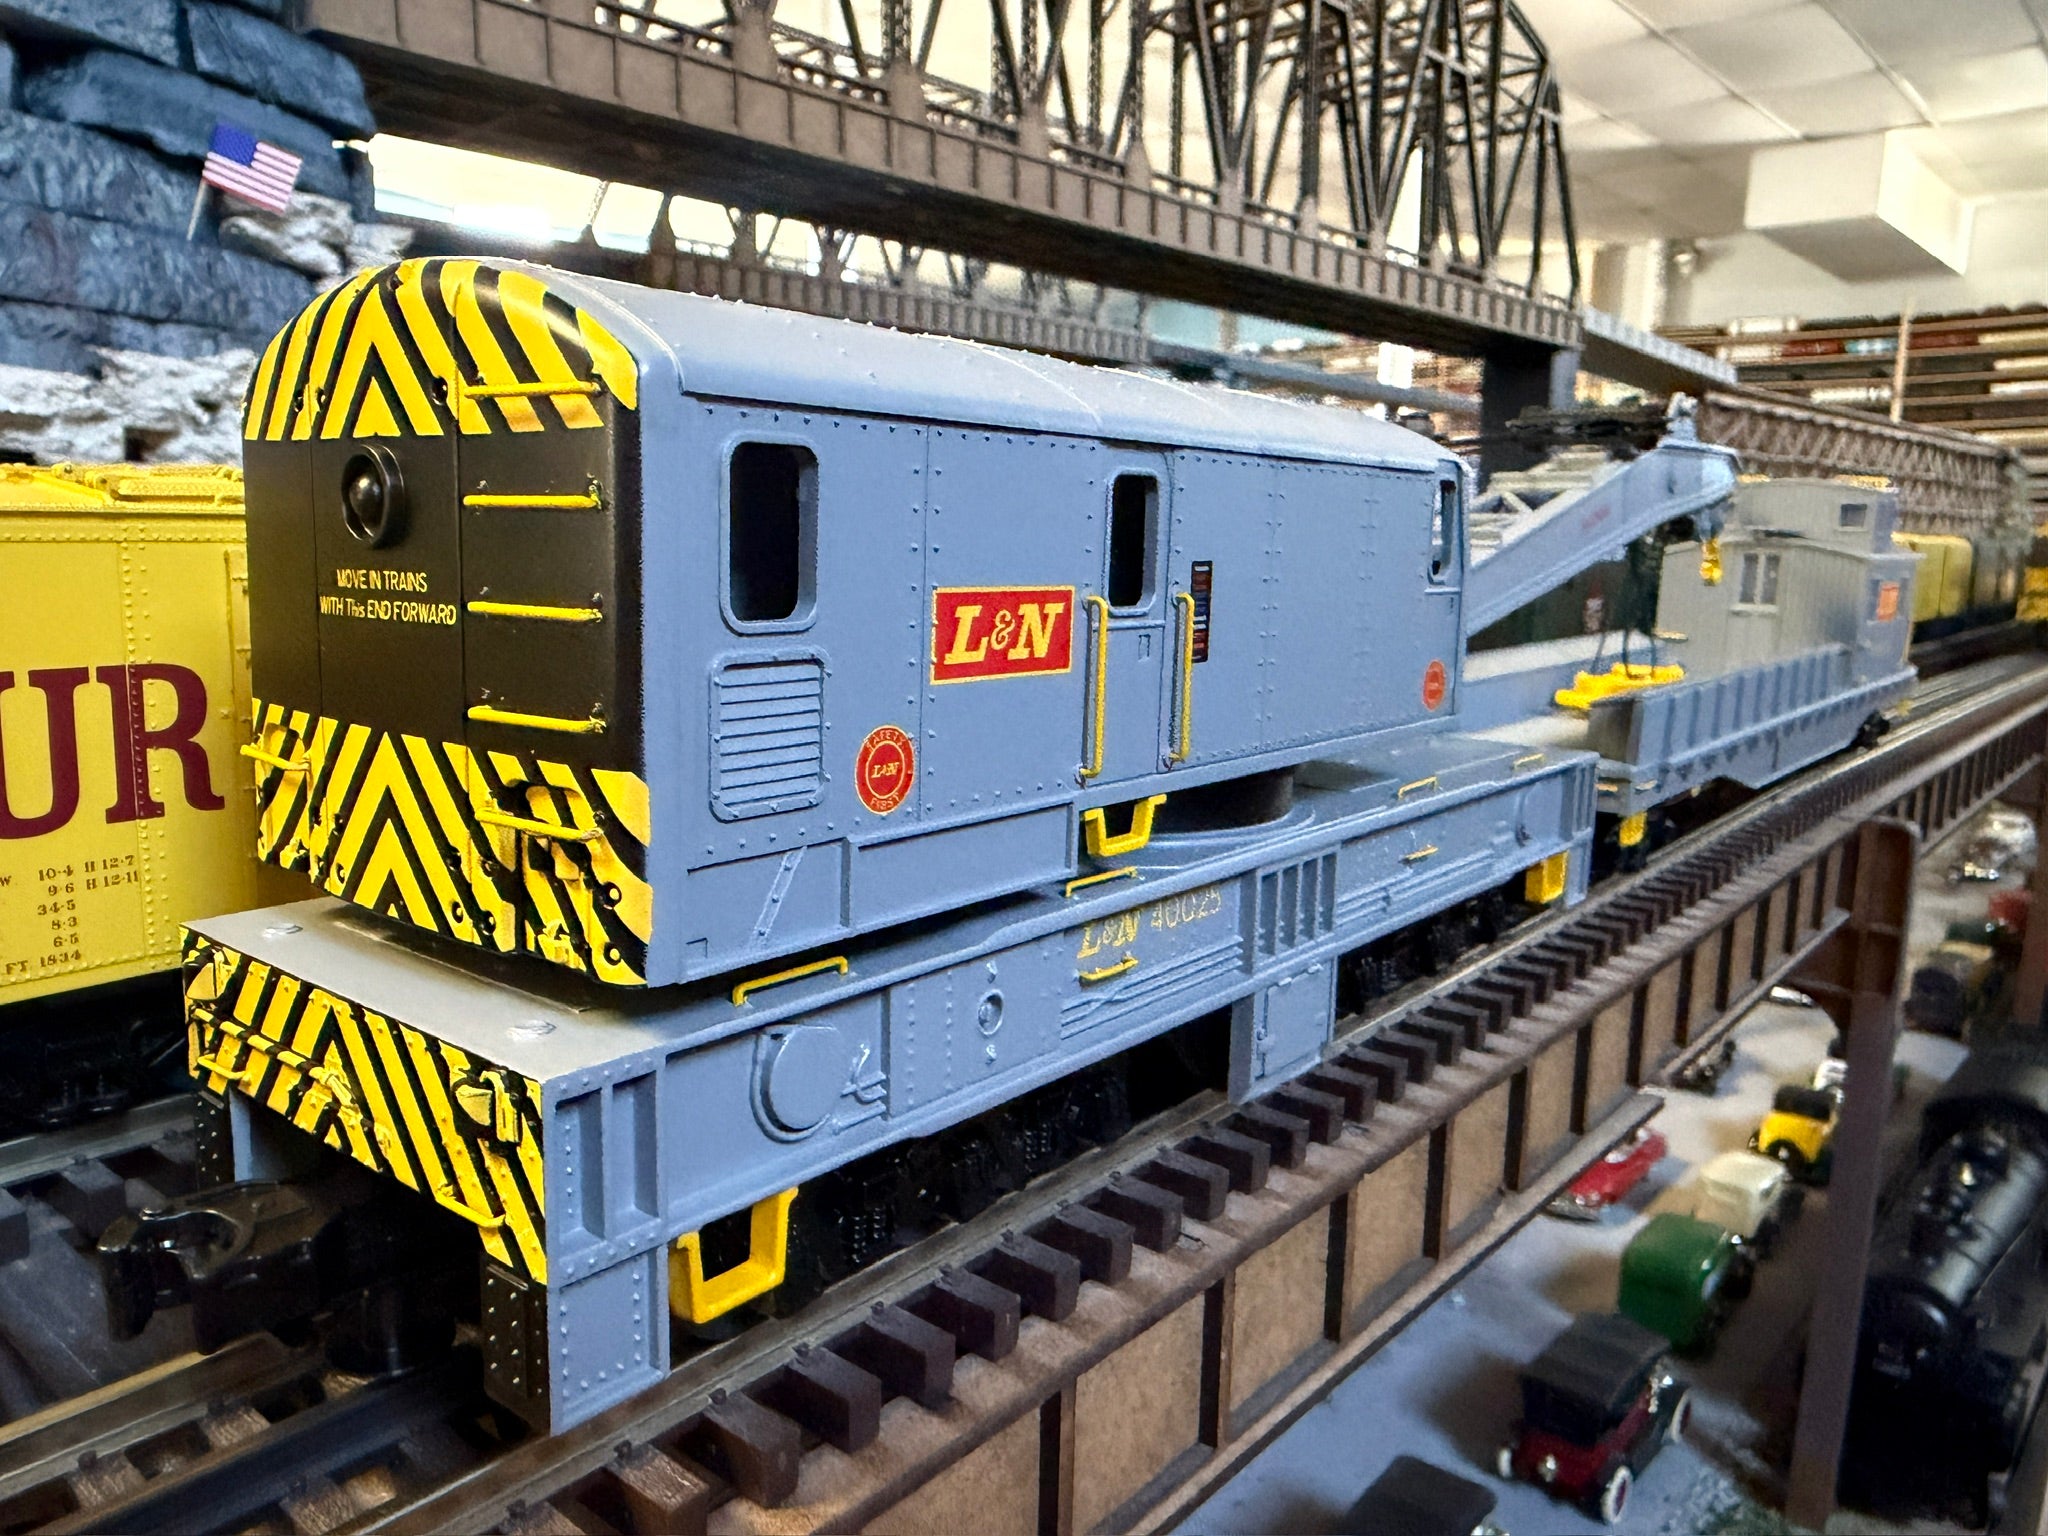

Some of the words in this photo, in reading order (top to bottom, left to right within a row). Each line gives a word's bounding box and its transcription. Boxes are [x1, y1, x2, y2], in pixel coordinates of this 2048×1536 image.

[336, 568, 367, 589] MOVE
[369, 570, 381, 590] IN
[383, 570, 428, 593] TRAINS
[319, 595, 343, 616] WITH
[367, 599, 391, 620] END
[393, 601, 457, 625] FORWARD
[943, 602, 1066, 665] L&N
[1077, 907, 1142, 960] L&N
